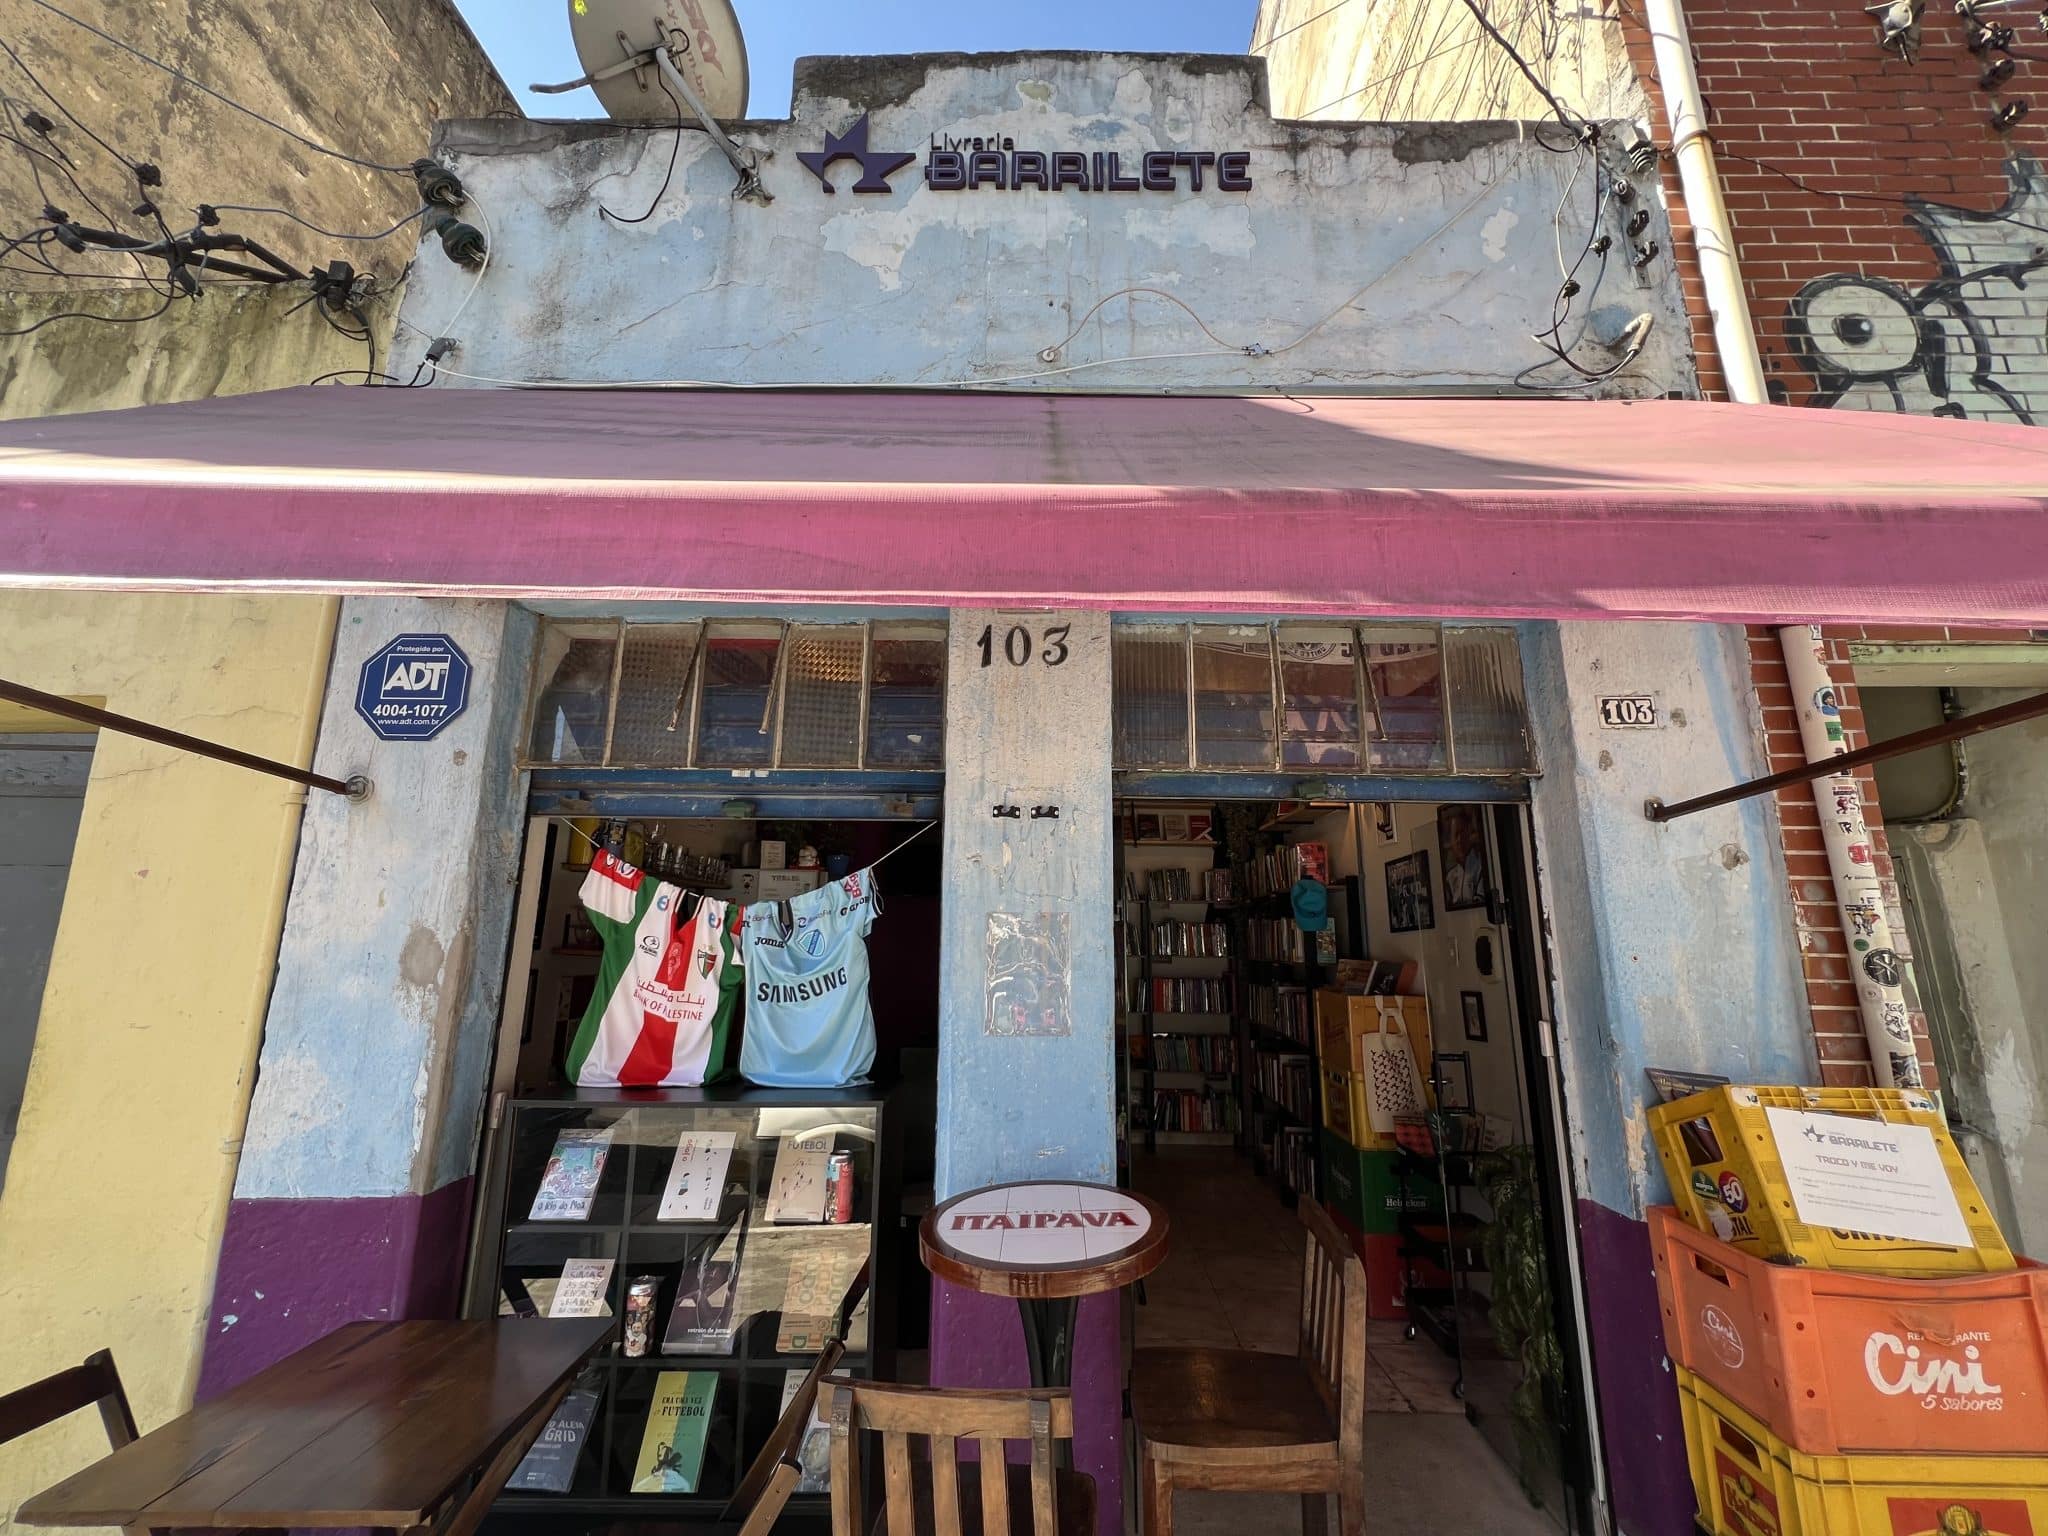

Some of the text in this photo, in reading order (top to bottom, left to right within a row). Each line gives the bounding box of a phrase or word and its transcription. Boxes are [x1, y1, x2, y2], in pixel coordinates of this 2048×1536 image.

[930, 132, 1015, 152] Livraria
[924, 151, 1253, 192] BARRILETE
[396, 645, 431, 653] Protegido
[977, 622, 1071, 668] 103
[383, 661, 449, 691] ADT
[373, 703, 448, 717] 4004-1077
[1605, 699, 1653, 724] 103
[377, 717, 440, 726] www.adt.com.br
[757, 966, 847, 1003] SAMSUNG
[650, 1000, 664, 1012] OF
[663, 1004, 705, 1020] PLESTINE
[1828, 1135, 1899, 1153] BARRILETE
[1722, 1180, 1742, 1204] 50
[1385, 1198, 1426, 1207] Heieken
[950, 1210, 1139, 1230] ITAIPAVA
[1907, 1331, 1992, 1346] RERANTE
[1864, 1331, 2002, 1396] Cini
[661, 1406, 705, 1416] FUTEBOL
[1921, 1394, 2003, 1411] 5 sabores
[545, 1428, 576, 1442] GRID
